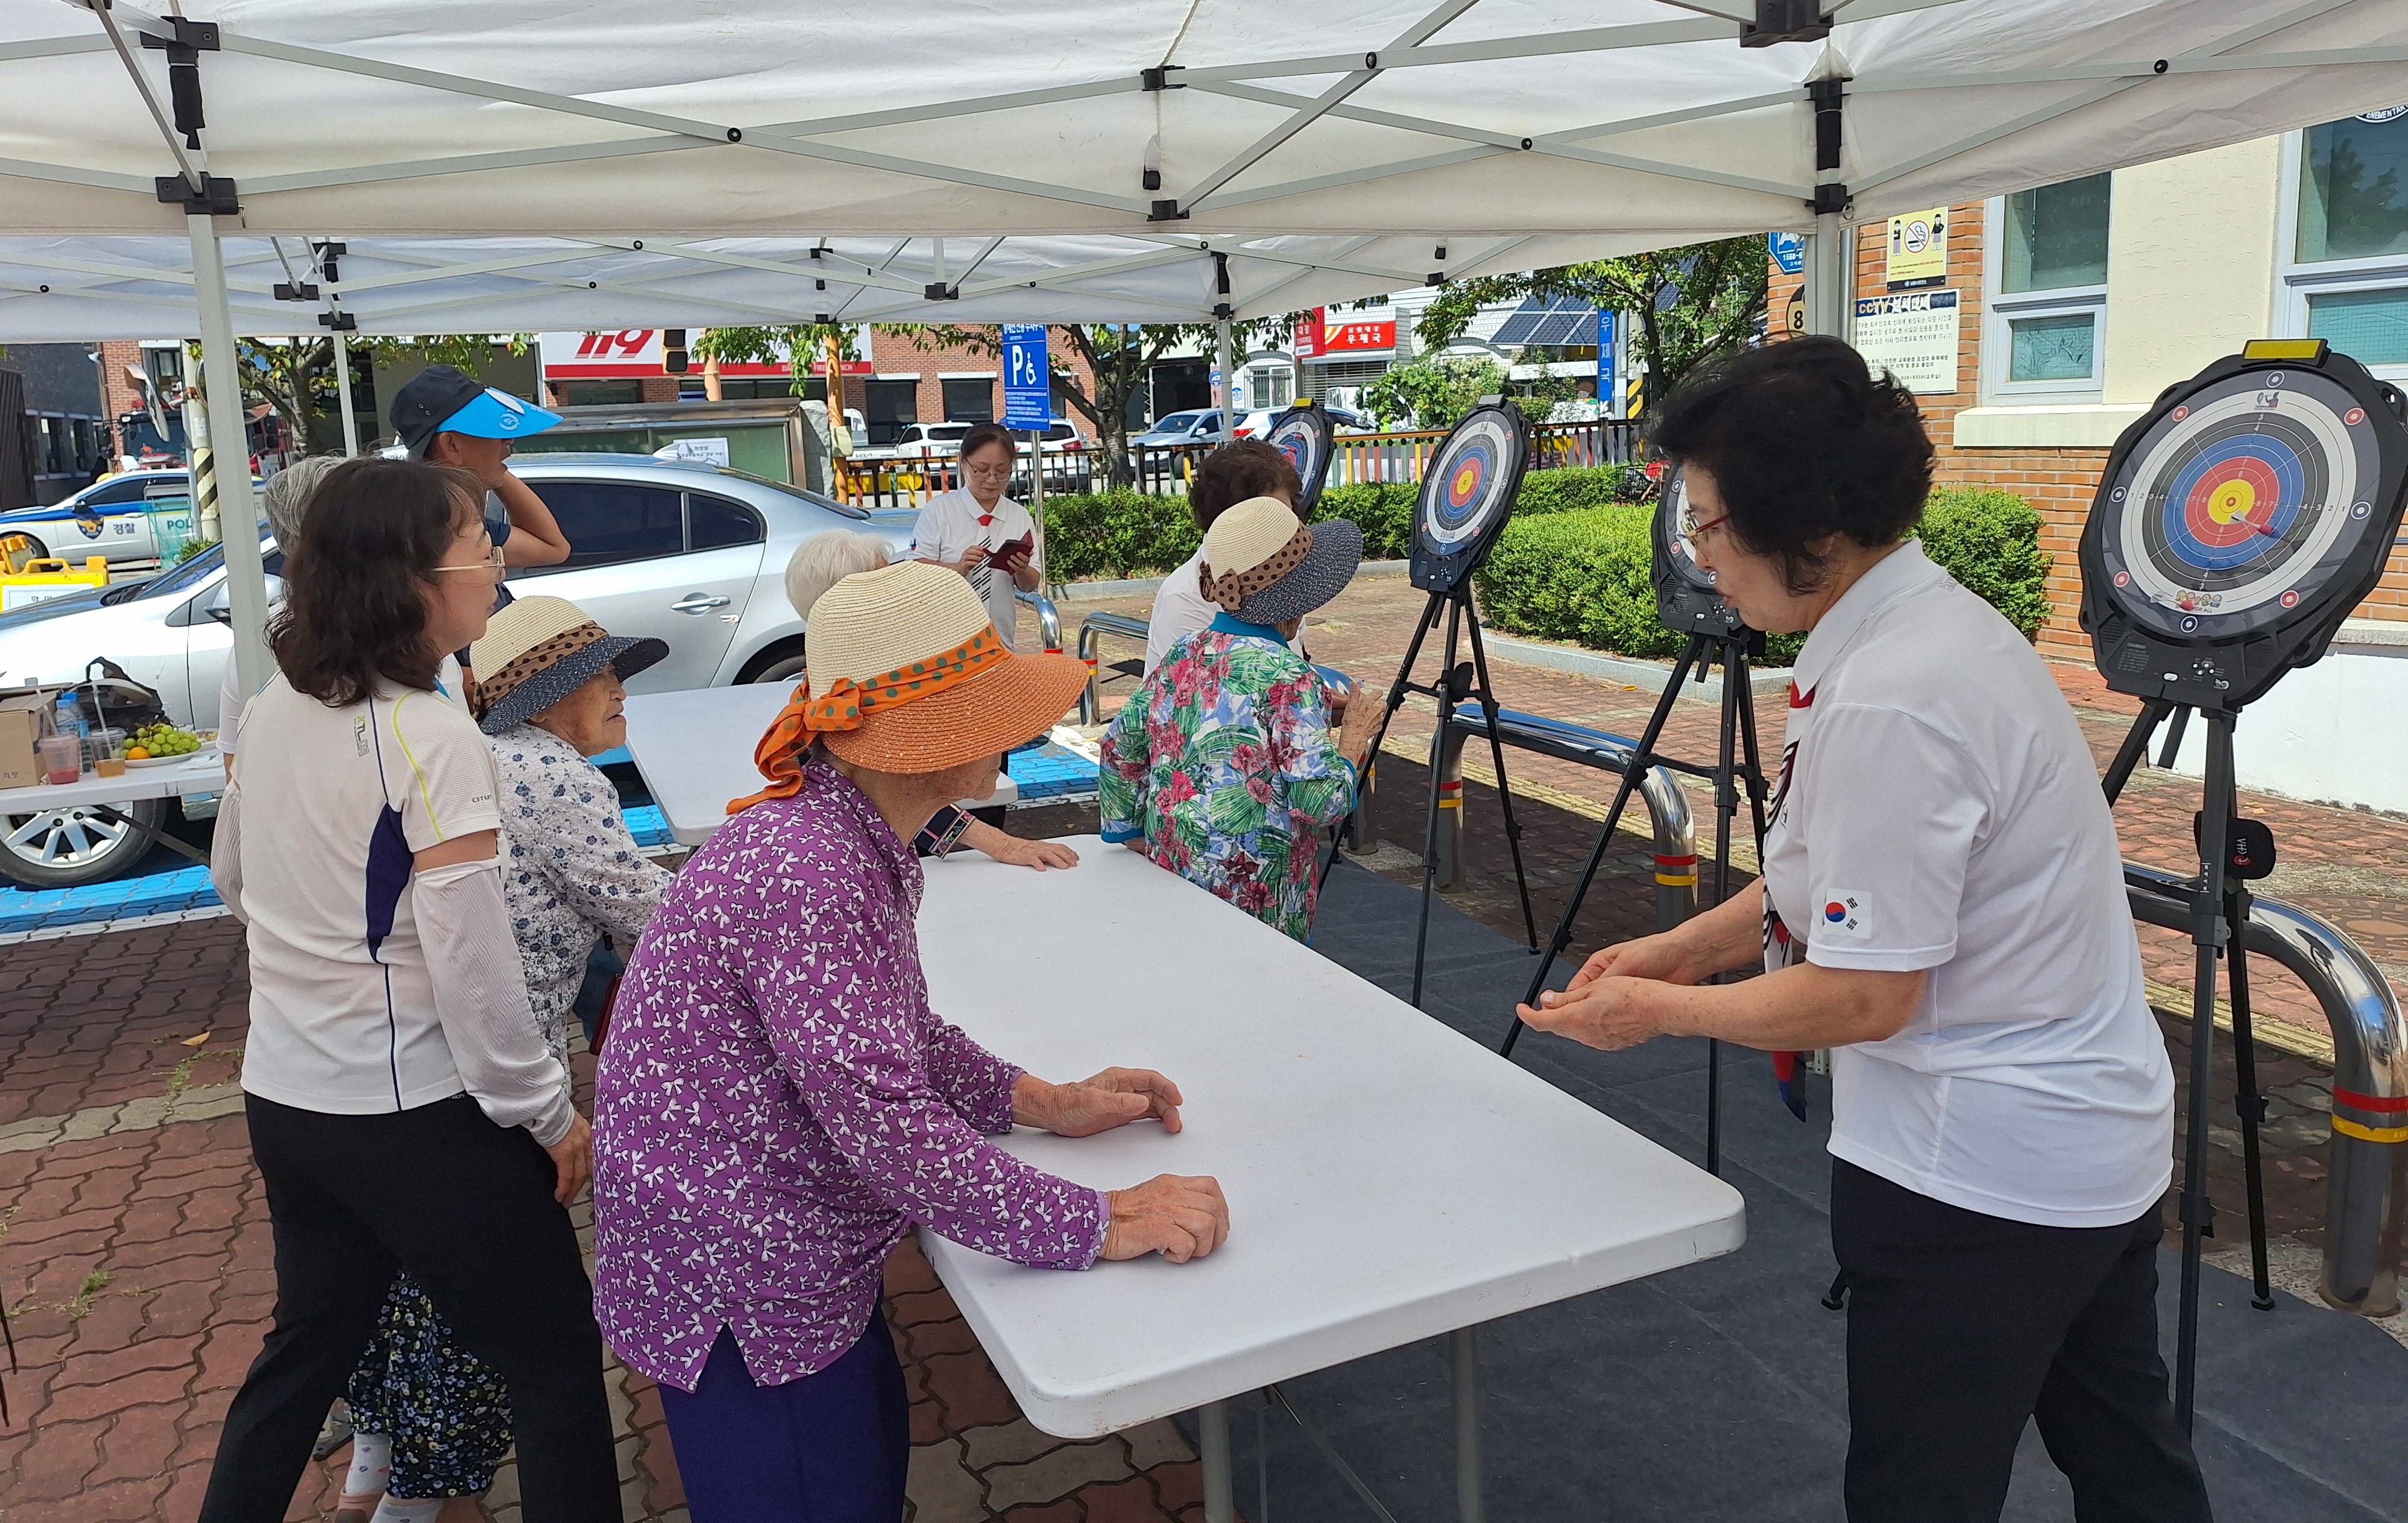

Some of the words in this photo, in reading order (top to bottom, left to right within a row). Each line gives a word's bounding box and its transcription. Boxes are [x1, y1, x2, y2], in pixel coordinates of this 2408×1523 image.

[1347, 333, 1381, 345] 우체국
[1600, 317, 1610, 383] 우체국
[1012, 345, 1023, 386] P
[113, 523, 135, 535] 경찰
[167, 519, 191, 530] POL
